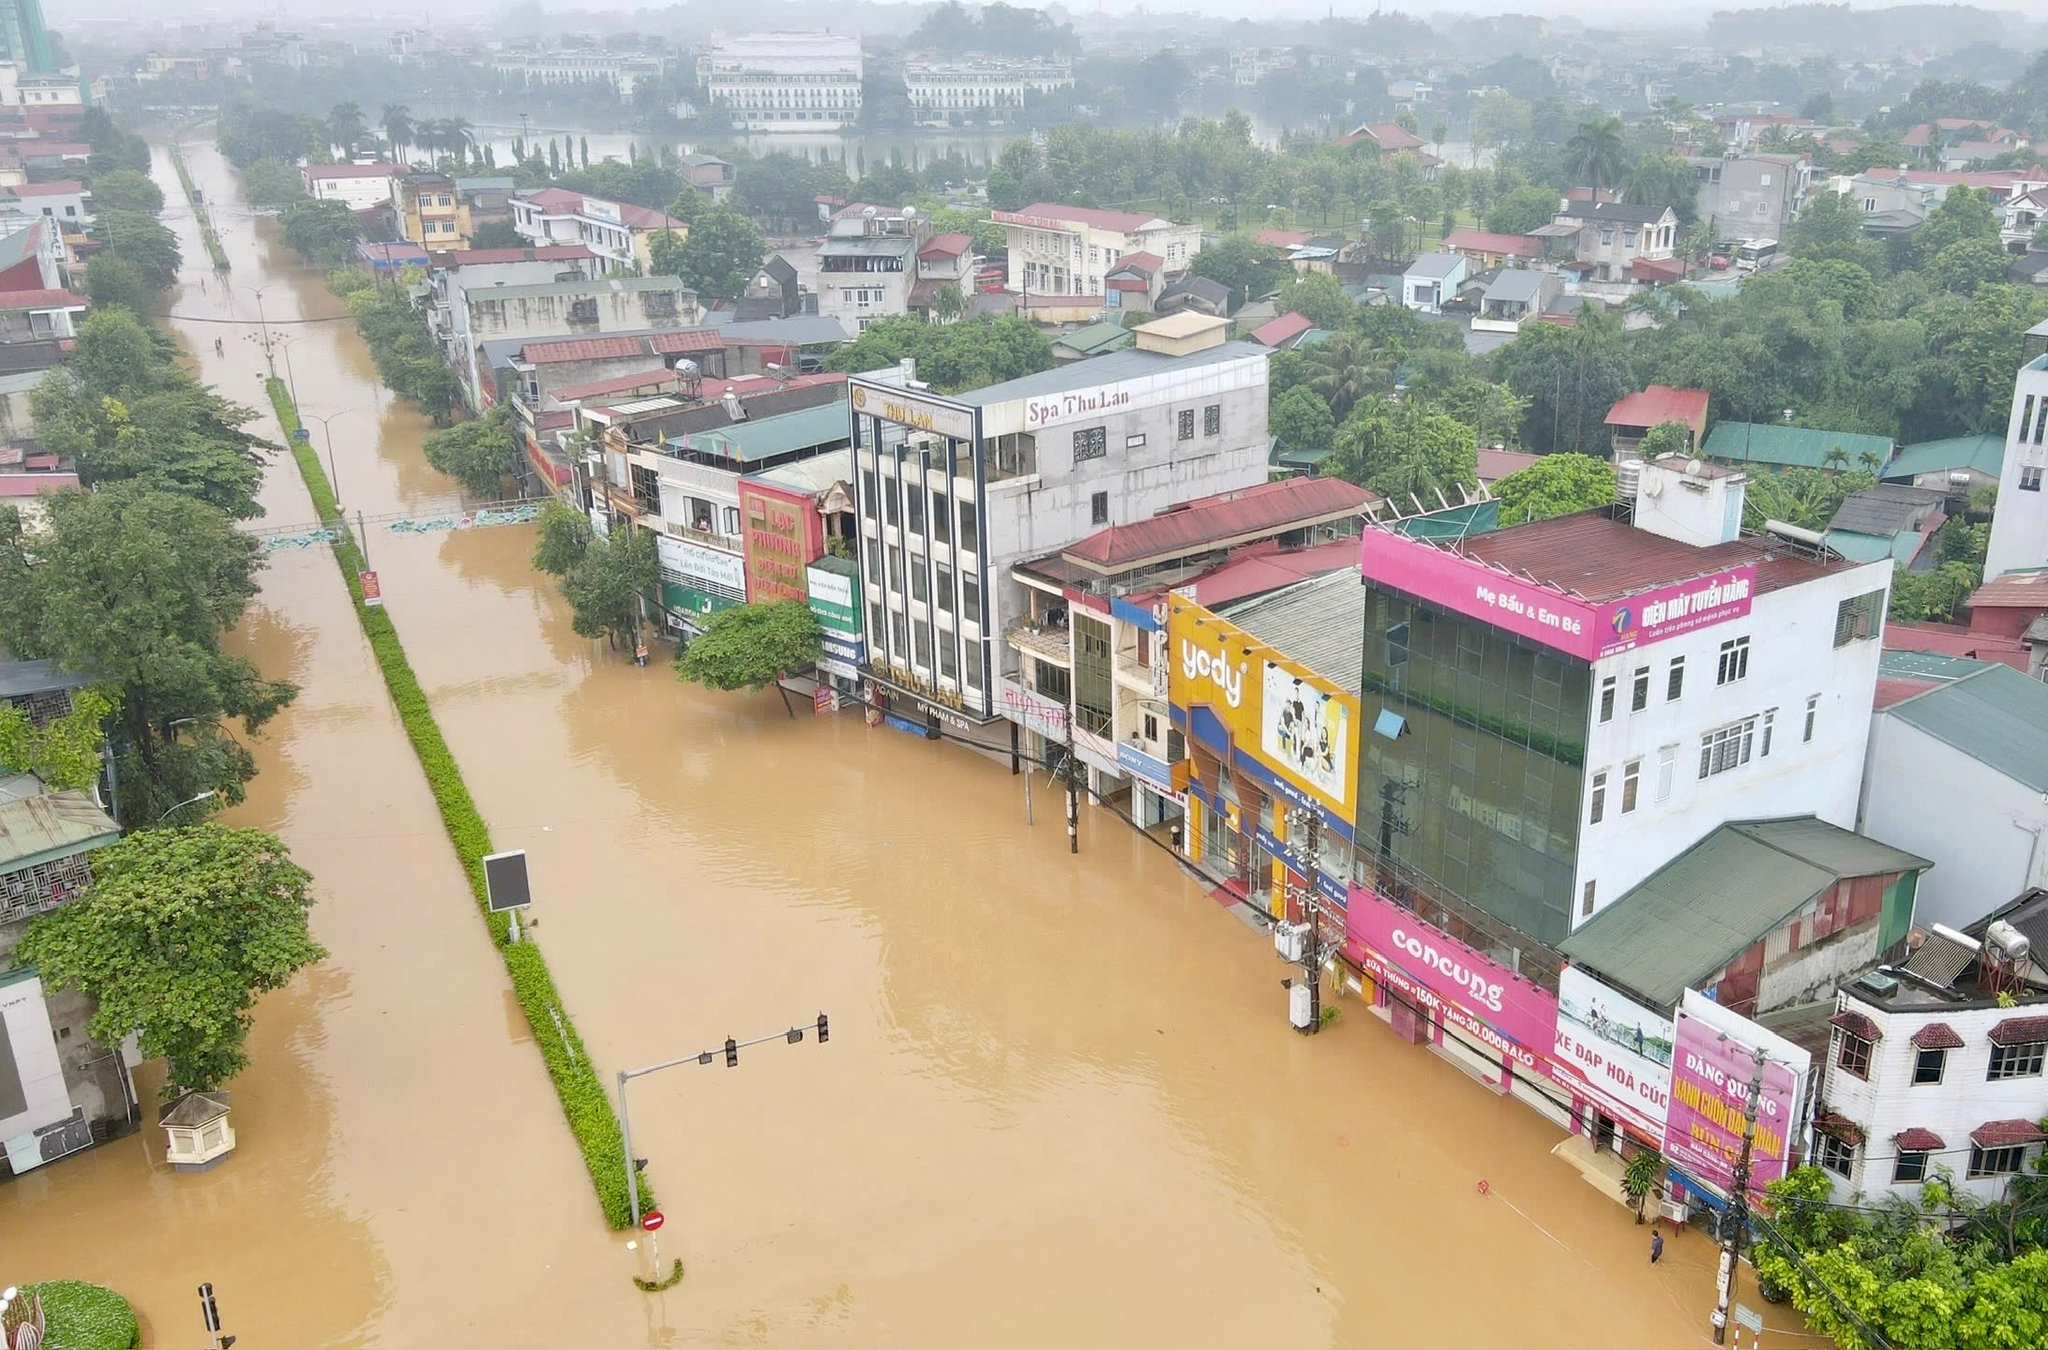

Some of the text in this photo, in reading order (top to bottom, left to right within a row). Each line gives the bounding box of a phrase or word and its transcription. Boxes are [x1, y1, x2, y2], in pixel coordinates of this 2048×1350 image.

[883, 402, 933, 429] THU LAN
[1030, 390, 1129, 424] Spa Thu Lan
[1476, 586, 1496, 606] Mẹ
[1526, 606, 1535, 619] &
[1538, 608, 1559, 628] Em
[1562, 616, 1581, 635] Bé
[1642, 600, 1667, 628] ĐIỆN
[1667, 593, 1691, 620] MÁY
[889, 664, 921, 694] THU
[1182, 638, 1241, 708] yody
[956, 717, 970, 732] SPA
[1392, 929, 1504, 1012] concung
[1555, 1030, 1572, 1052] XE
[1575, 1042, 1602, 1067] ĐẠP
[1640, 1082, 1667, 1109] CÚC
[1686, 1053, 1724, 1086] ĐĂNG
